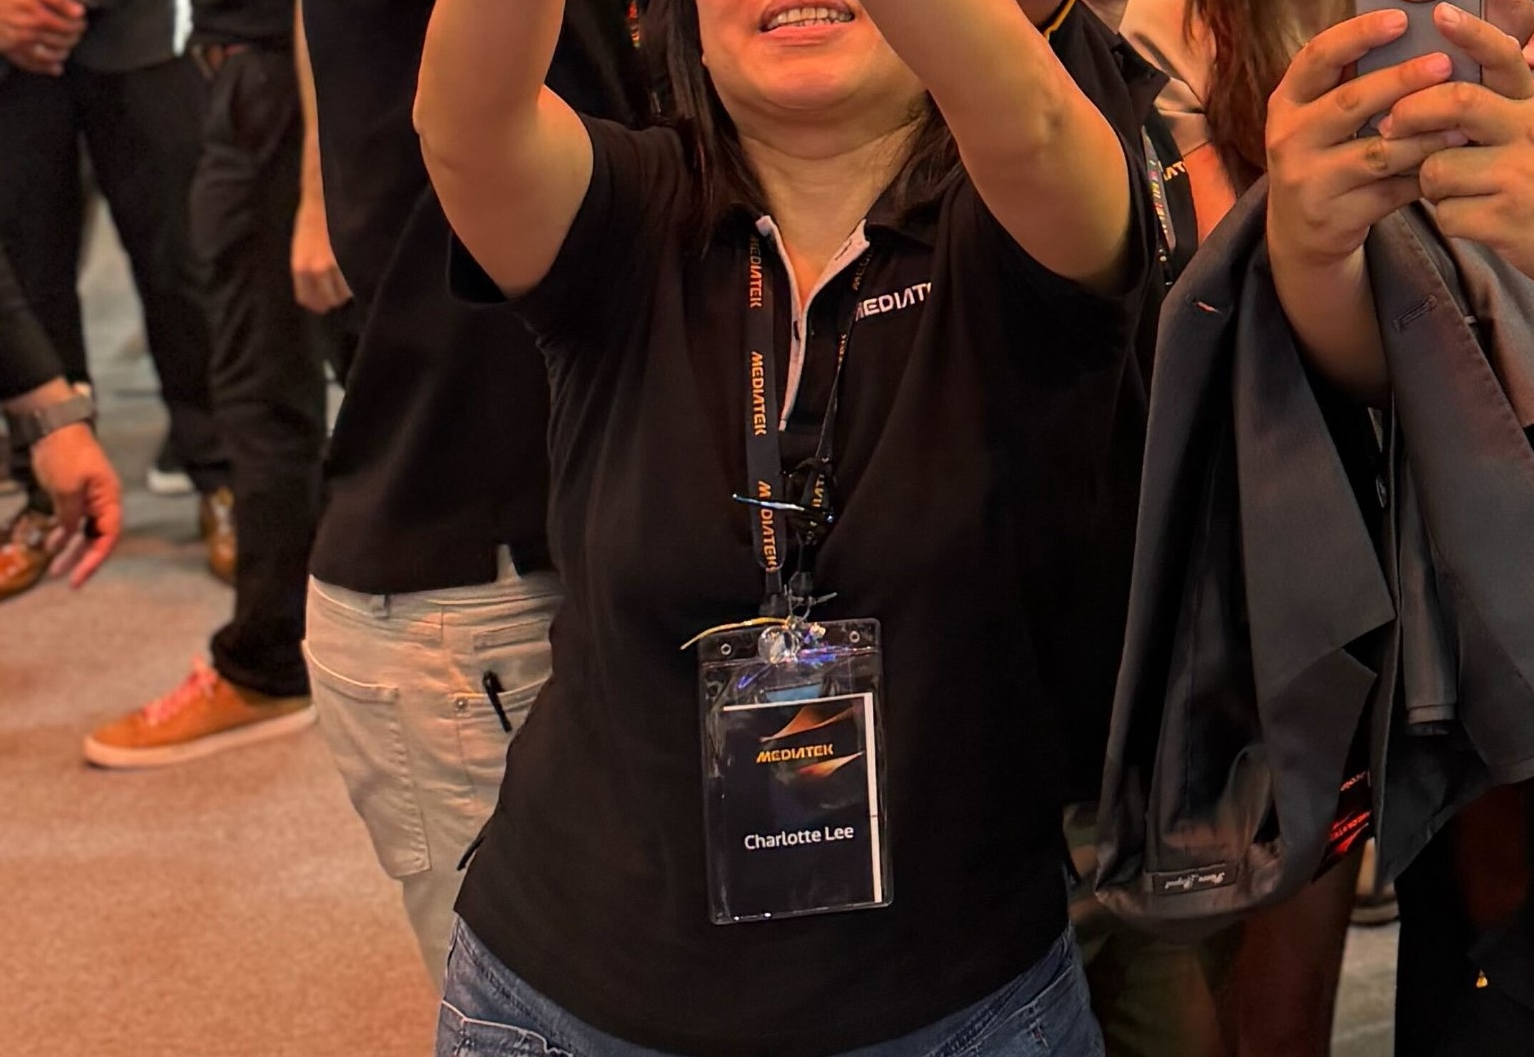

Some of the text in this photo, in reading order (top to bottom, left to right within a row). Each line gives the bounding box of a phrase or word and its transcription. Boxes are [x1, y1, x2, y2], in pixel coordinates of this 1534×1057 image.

[751, 351, 767, 436] MEDIATEK
[758, 480, 778, 573] MDIATEK
[756, 743, 834, 763] MEDIATEK
[744, 826, 854, 850] Charlotte Lee
